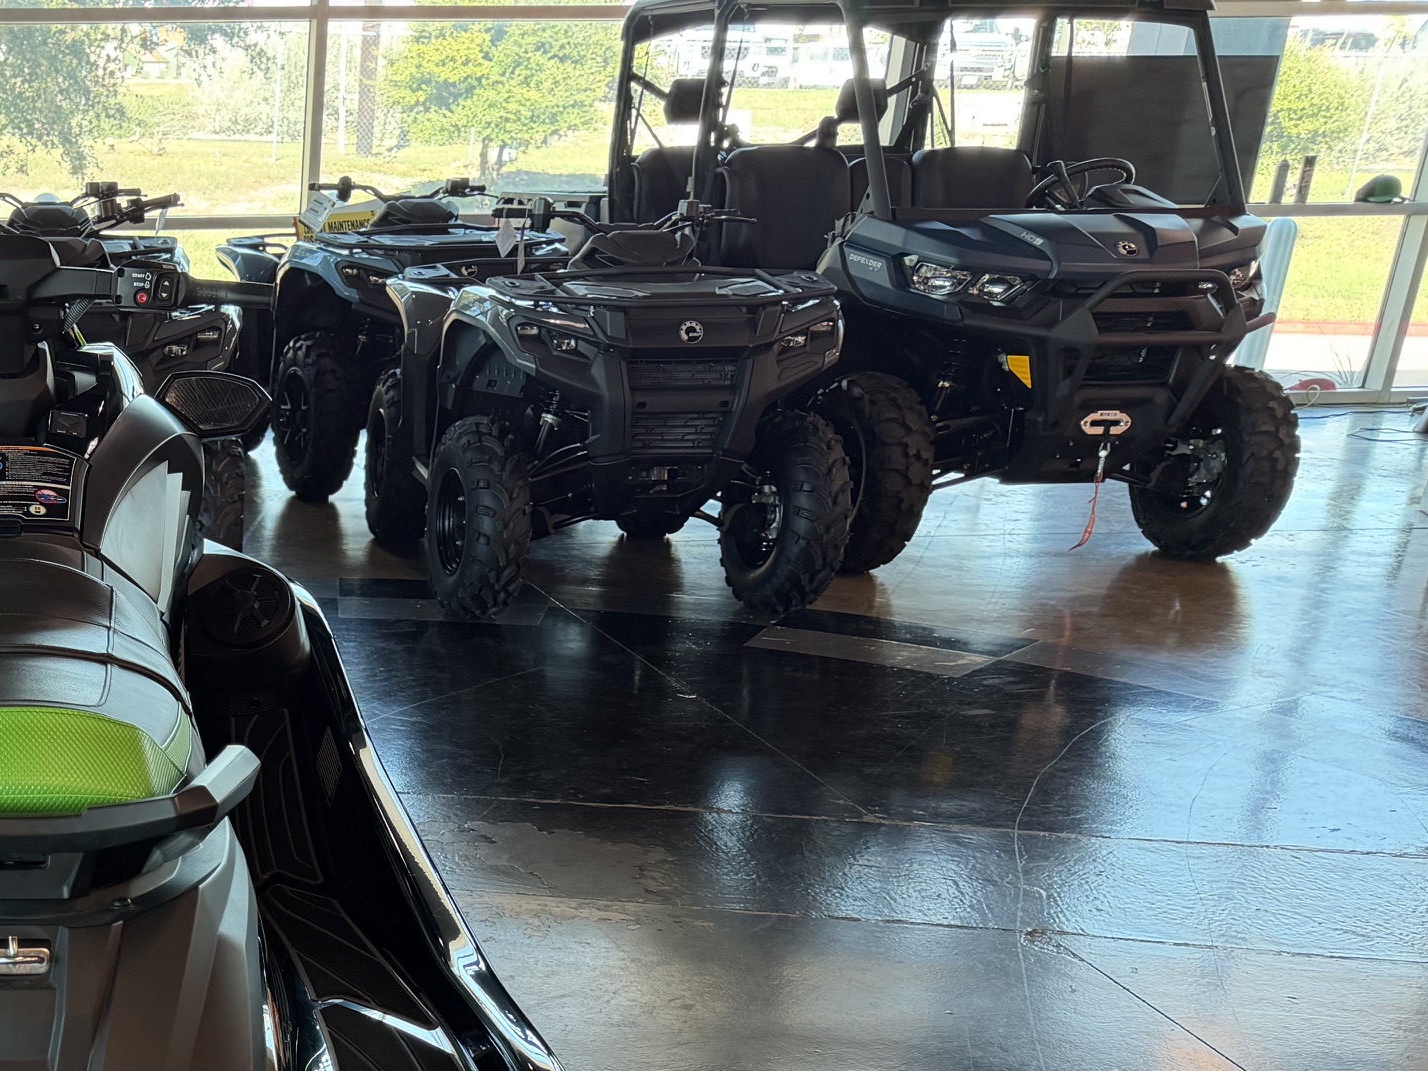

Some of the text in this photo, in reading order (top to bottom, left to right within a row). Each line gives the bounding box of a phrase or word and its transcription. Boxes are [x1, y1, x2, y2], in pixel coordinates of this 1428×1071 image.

[327, 218, 371, 232] MAINTENANCE
[1020, 231, 1044, 246] HD9
[848, 253, 883, 268] DEFENDER
